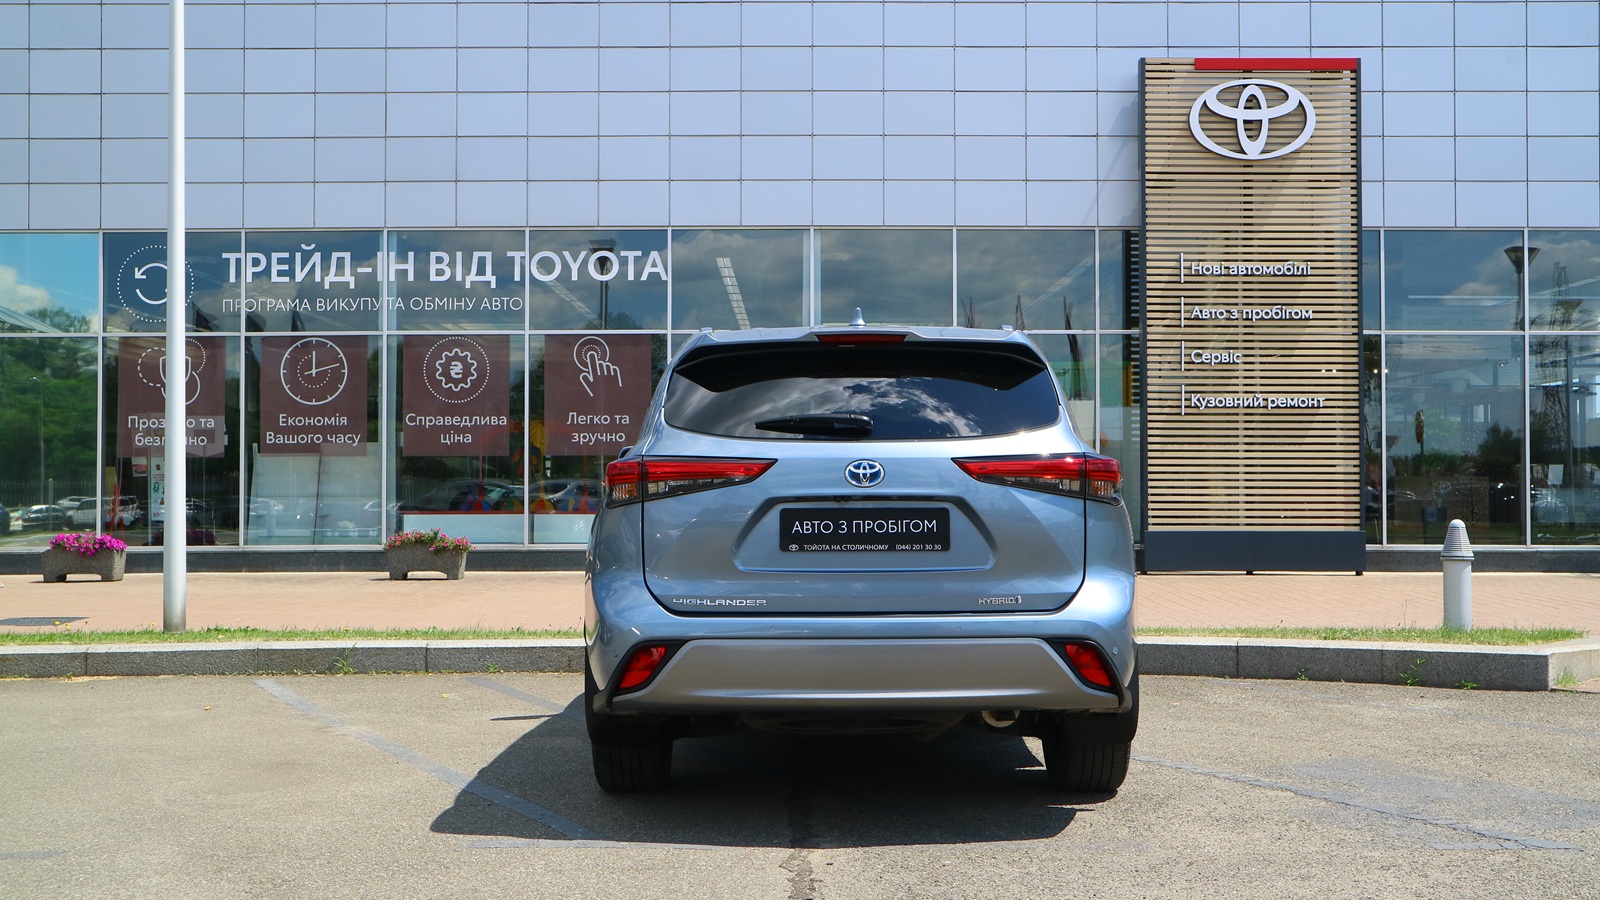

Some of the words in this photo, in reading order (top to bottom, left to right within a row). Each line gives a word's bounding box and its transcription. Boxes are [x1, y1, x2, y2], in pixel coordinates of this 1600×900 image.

[221, 243, 415, 290] ТРЕЙД-ІН
[429, 251, 497, 289] ВІД
[506, 250, 669, 282] TOYOTA
[1190, 261, 1226, 276] Нові
[1229, 261, 1312, 276] автомобілі
[222, 298, 312, 313] ПРОГРАМА
[316, 297, 382, 312] ВИКУПУ
[386, 297, 406, 311] ТА
[409, 297, 477, 311] ОБМІНУ
[480, 296, 524, 311] АВТО
[1190, 306, 1227, 320] Авто
[1230, 310, 1239, 320] з
[1242, 305, 1314, 322] пробігом
[1190, 349, 1243, 366] Сервіс
[1190, 393, 1265, 411] Кузовний
[1268, 397, 1326, 411] ремонт
[128, 416, 196, 431] Прозо
[199, 418, 216, 428] та
[279, 413, 348, 427] Економія
[405, 413, 508, 427] Справедлива
[567, 412, 611, 425] Легко
[614, 414, 630, 424] та
[135, 433, 207, 446] безно
[266, 432, 324, 444] Вашого
[327, 434, 361, 447] часу
[440, 432, 473, 445] ціна
[571, 432, 626, 444] зручно
[791, 520, 834, 534] АВТО
[852, 519, 938, 533] ПРОБІГОМ
[803, 543, 831, 551] ТОЙОТА
[673, 598, 767, 606] HIGHLANDER
[978, 597, 1017, 605] HYBRID
